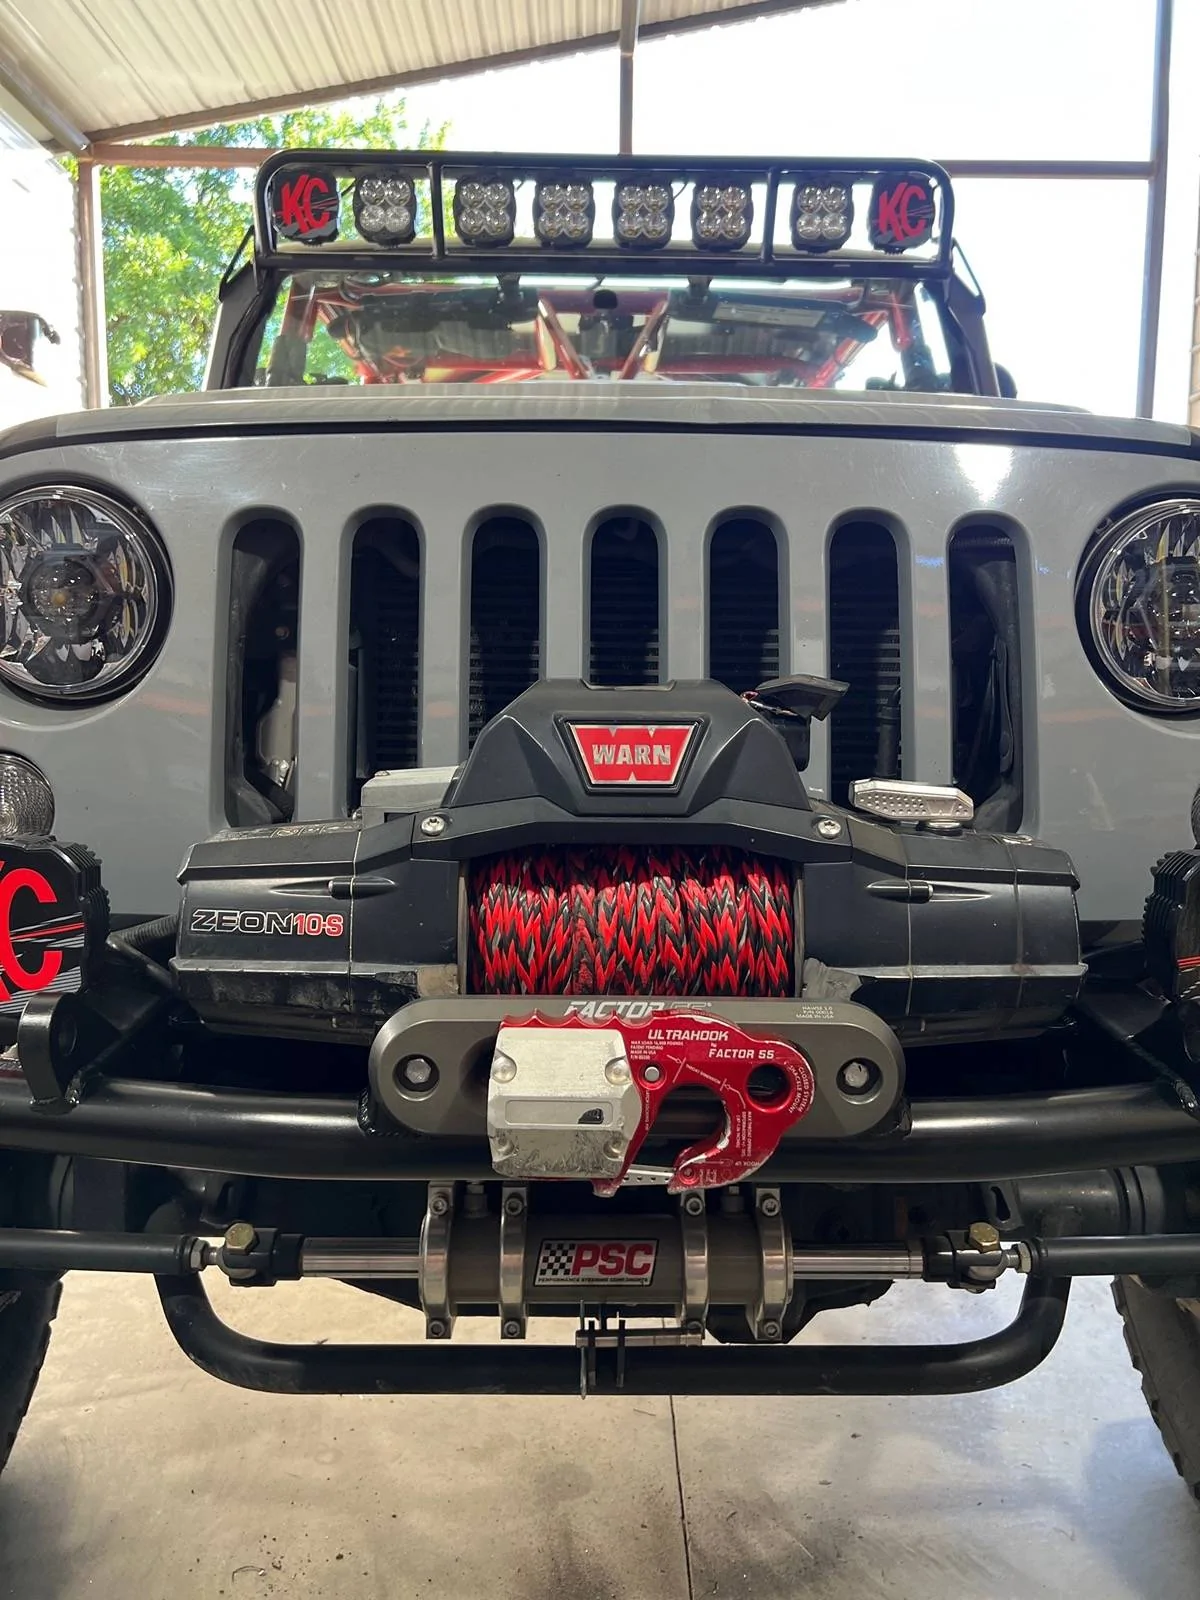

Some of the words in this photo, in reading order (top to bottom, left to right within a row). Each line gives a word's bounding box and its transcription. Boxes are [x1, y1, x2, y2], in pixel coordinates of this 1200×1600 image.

[279, 174, 330, 234] KC
[878, 182, 927, 241] KC
[592, 744, 671, 766] WARN
[0, 860, 63, 1002] C
[648, 1029, 729, 1042] ULTRAHOOK
[708, 1049, 755, 1059] FACTOR
[758, 1050, 775, 1060] 55
[572, 1243, 653, 1276] PSC
